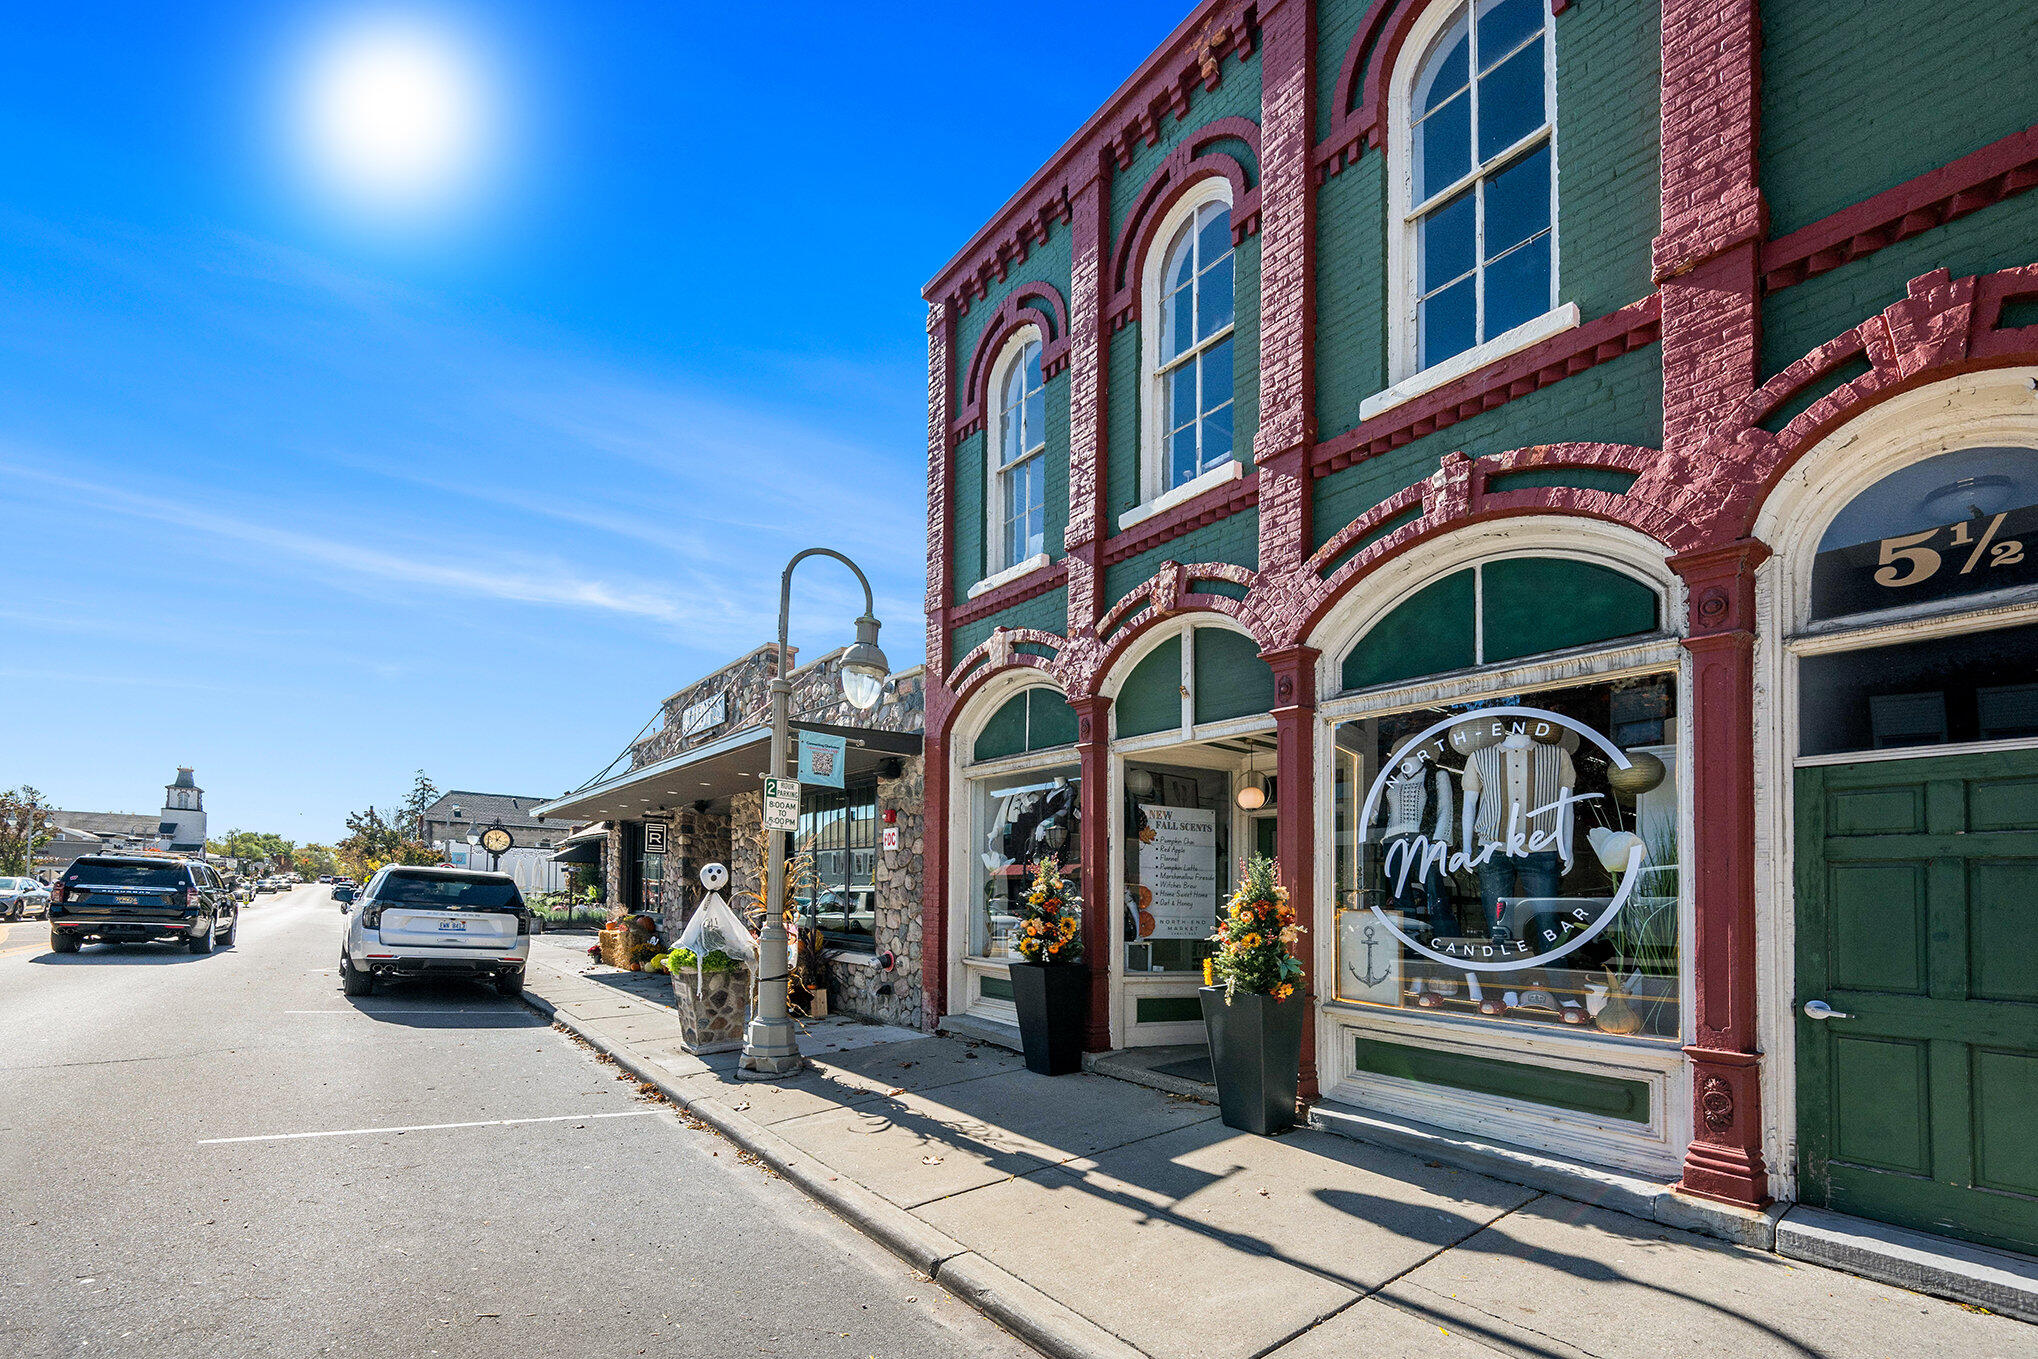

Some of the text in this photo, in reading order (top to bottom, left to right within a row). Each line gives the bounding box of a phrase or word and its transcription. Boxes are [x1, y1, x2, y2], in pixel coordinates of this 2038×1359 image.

[1386, 722, 1550, 789] NORTH-END
[767, 781, 794, 795] 2 HOUR
[777, 790, 798, 798] PARKING
[1149, 810, 1173, 820] NEW
[1156, 821, 1212, 832] FALL SCENTS
[649, 832, 661, 843] R
[884, 832, 896, 846] FDC
[1160, 836, 1182, 846] Pumpkin
[1384, 787, 1605, 898] Market
[1160, 845, 1185, 855] Red Apple
[1160, 863, 1183, 872] Pumpkin
[1160, 881, 1181, 889] Witches
[1176, 890, 1192, 898] Sweet
[1176, 900, 1193, 910] Honey
[1431, 907, 1589, 957] CANDLE BAR
